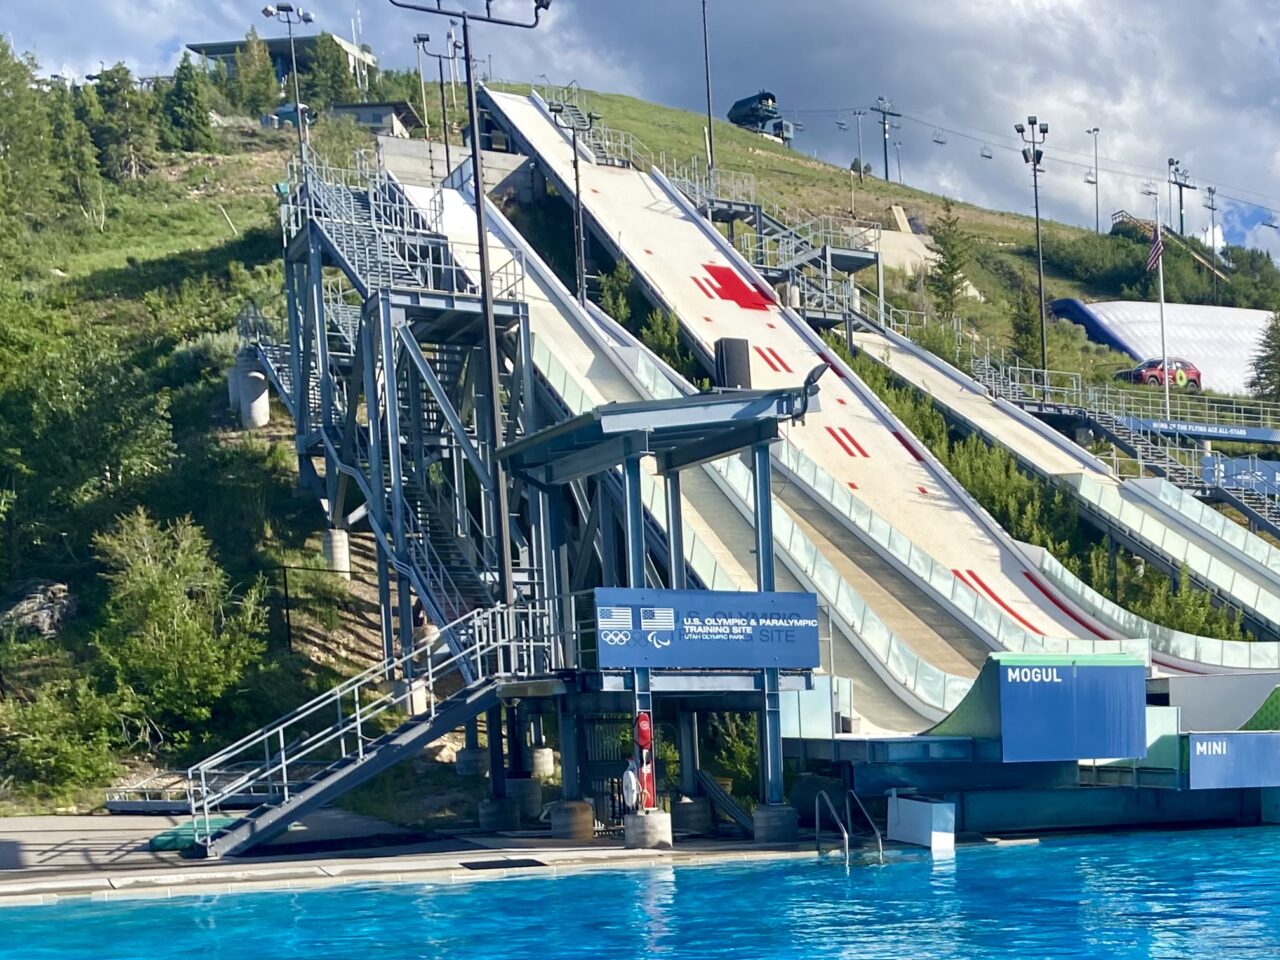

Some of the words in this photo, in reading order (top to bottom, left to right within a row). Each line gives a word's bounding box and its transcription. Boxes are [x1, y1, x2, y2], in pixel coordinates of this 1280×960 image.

[1189, 424, 1207, 433] FLYING
[1208, 426, 1218, 434] ACE
[1219, 427, 1247, 436] ALL-STARS
[683, 617, 702, 626] U.S.
[704, 617, 747, 626] OLYMPIC
[749, 618, 757, 626] &
[759, 618, 818, 627] PARALYMPIC
[683, 625, 730, 634] TRAINING
[732, 626, 753, 634] SITE
[701, 633, 728, 641] OLYMPIC
[728, 633, 745, 641] PARK
[1007, 667, 1062, 682] MOGUL
[1195, 741, 1227, 755] MINI
